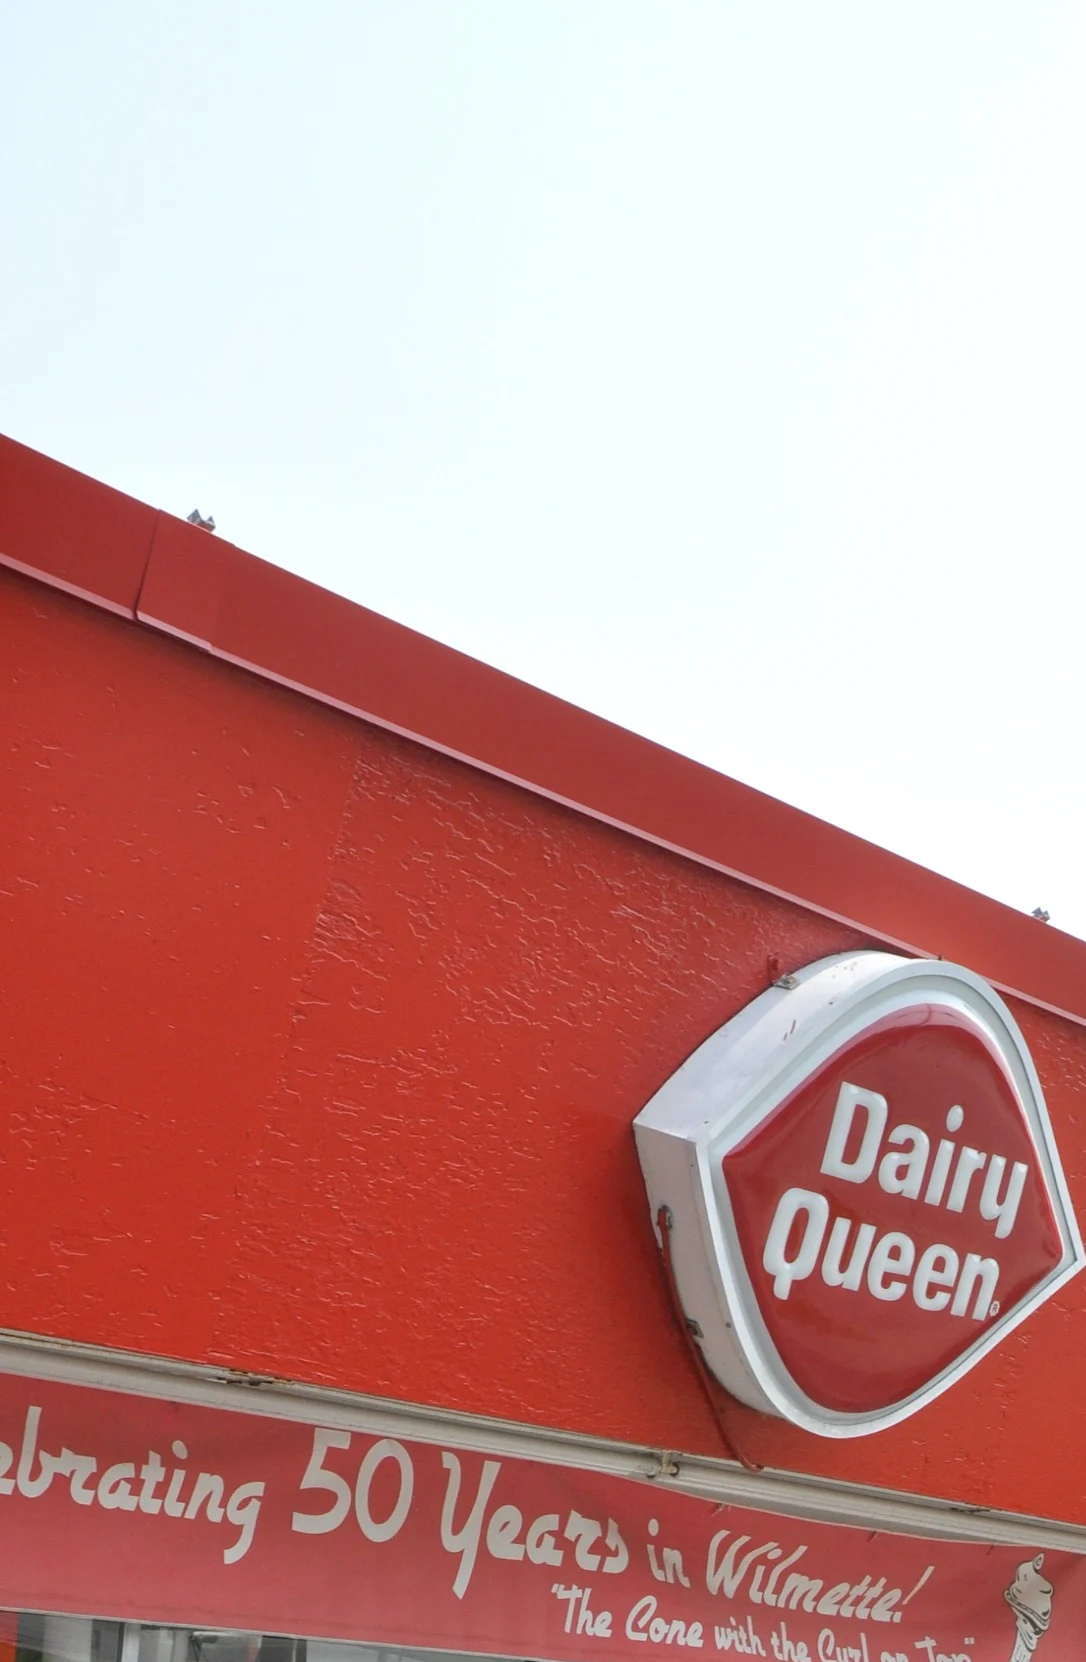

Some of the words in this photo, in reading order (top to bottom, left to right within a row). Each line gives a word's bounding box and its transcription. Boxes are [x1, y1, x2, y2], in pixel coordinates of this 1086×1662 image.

[821, 1080, 1029, 1239] Dairy
[762, 1187, 1000, 1322] Queen
[292, 1427, 414, 1543] 50
[441, 1451, 629, 1600] Years
[647, 1519, 690, 1588] in
[705, 1529, 934, 1624] Wilmette!
[551, 1583, 613, 1638] "The
[625, 1595, 704, 1648] Cone
[714, 1615, 767, 1657] with
